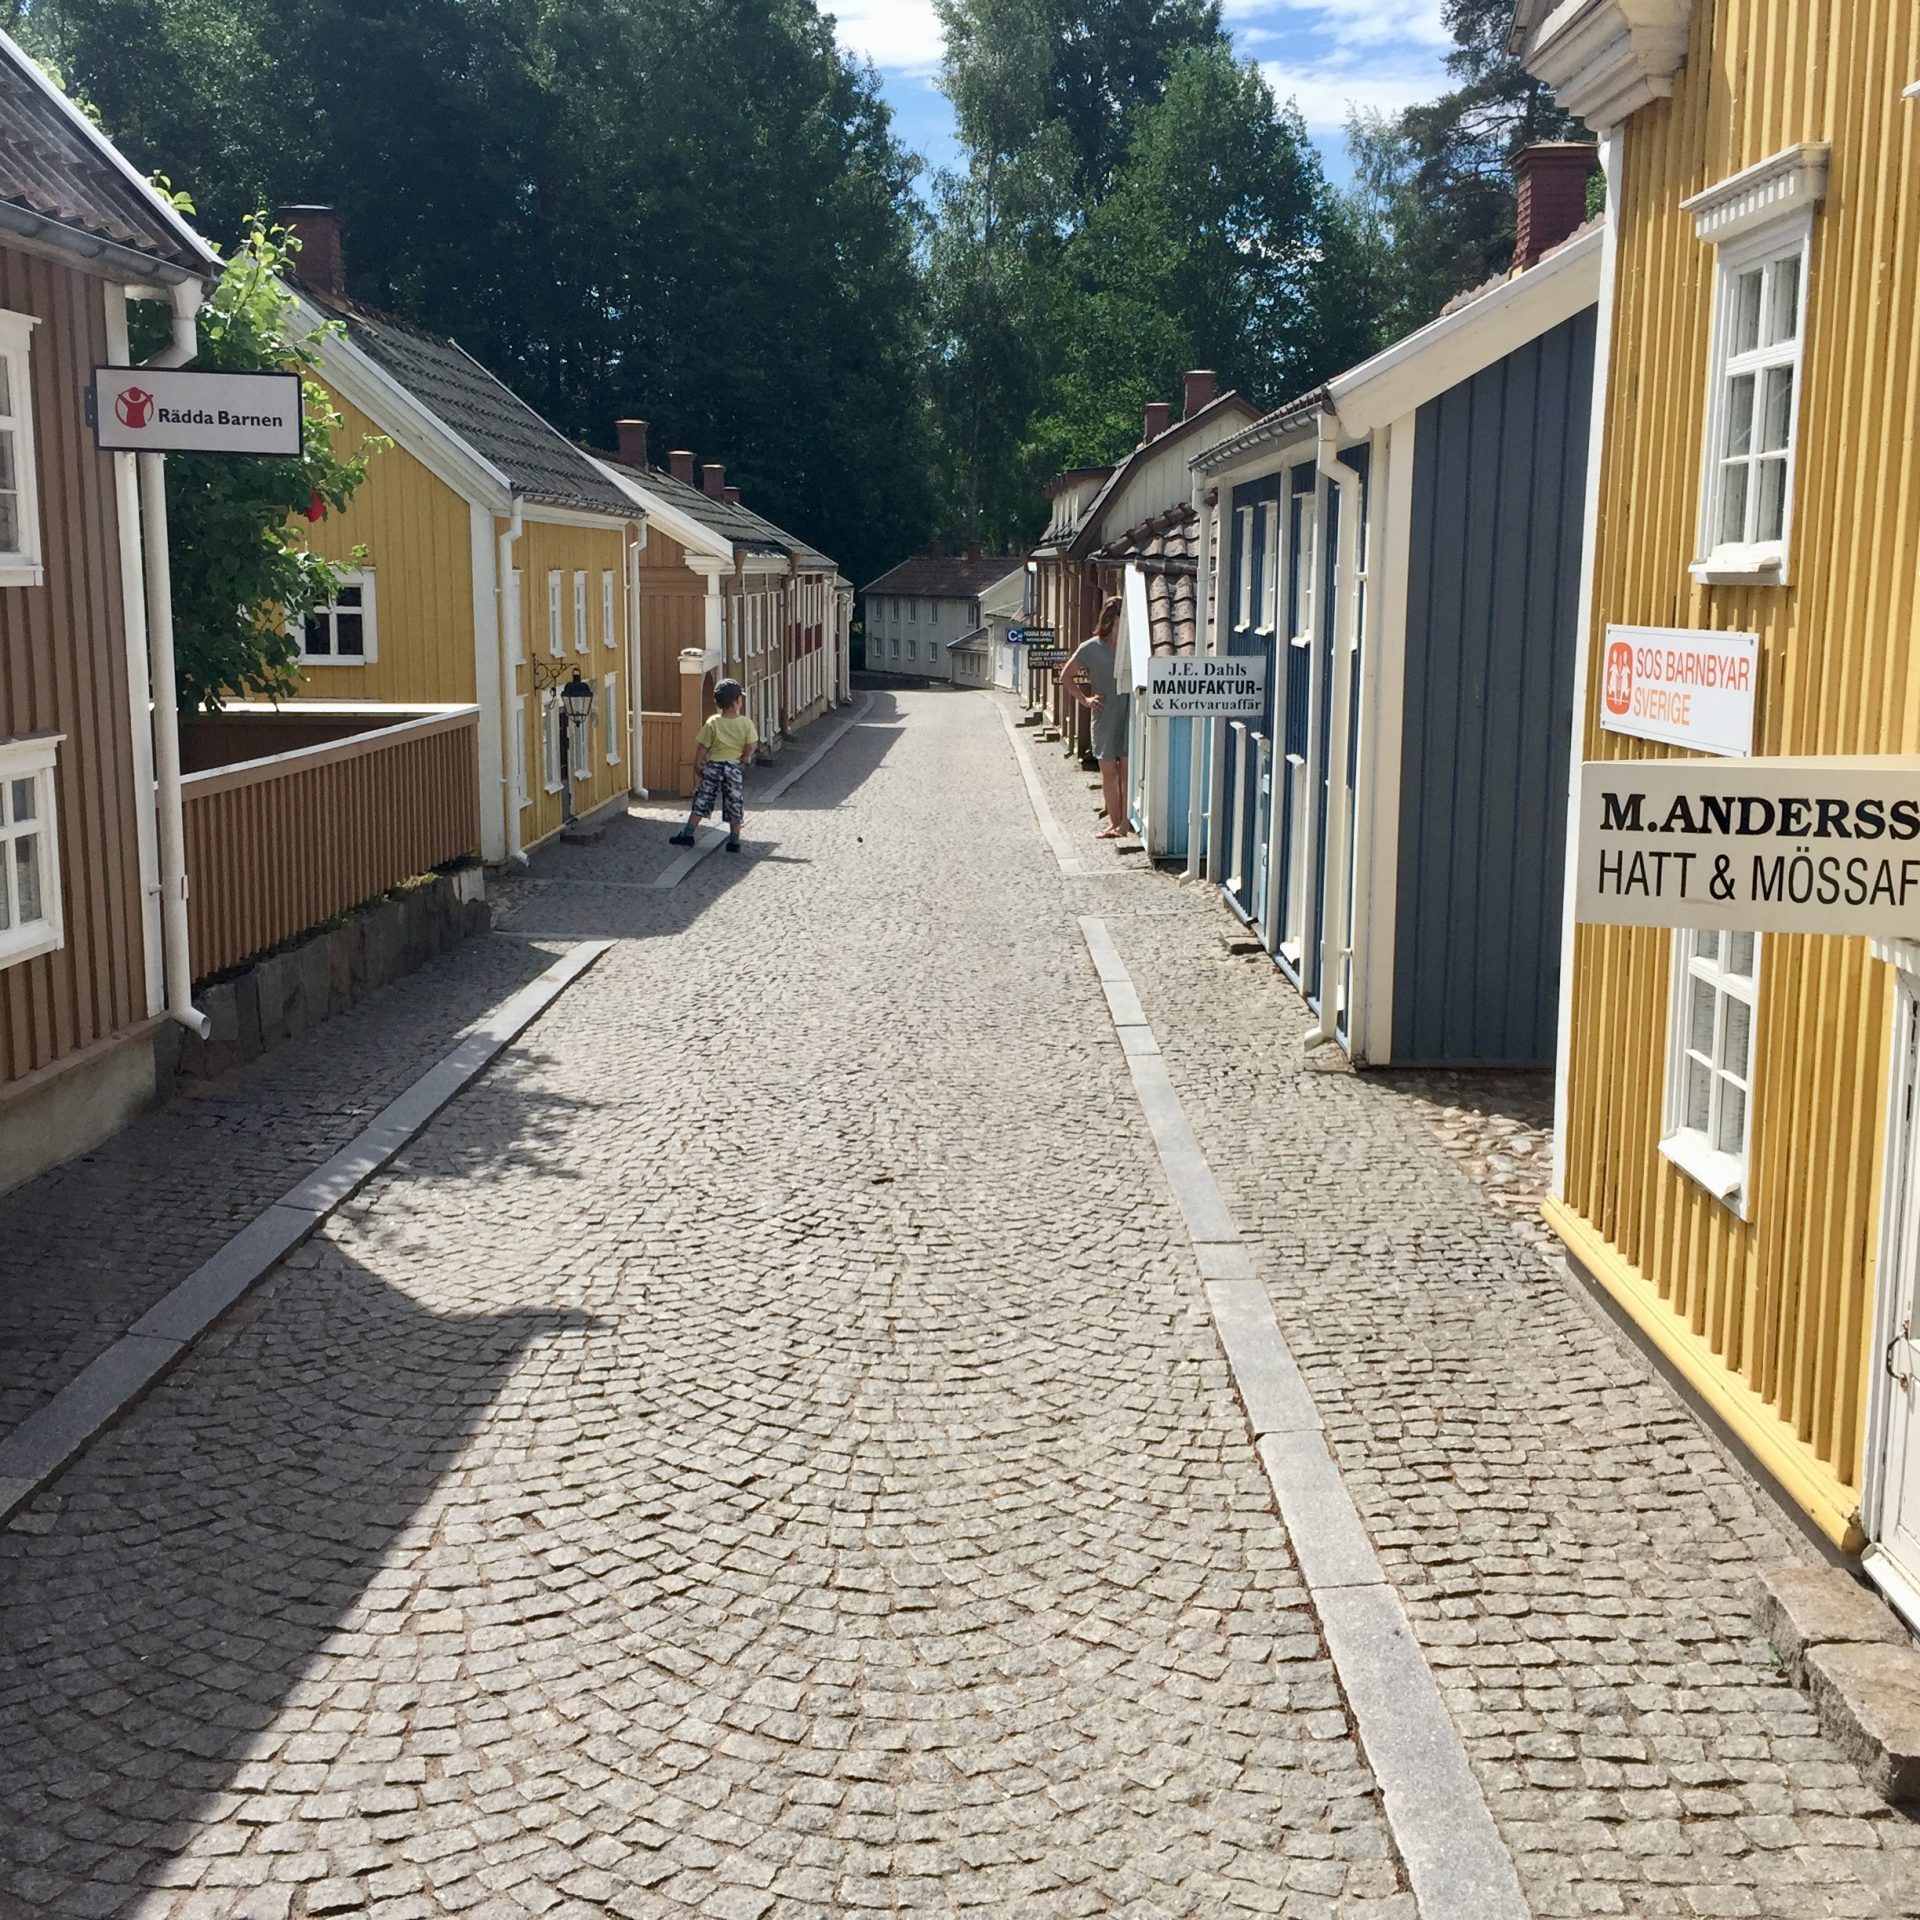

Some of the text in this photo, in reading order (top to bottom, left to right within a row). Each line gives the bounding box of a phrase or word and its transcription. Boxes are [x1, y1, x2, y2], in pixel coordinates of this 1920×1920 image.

[158, 408, 283, 427] Rädda Barnen
[1168, 662, 1247, 676] J.E. Dahls
[1636, 647, 1750, 692] SOS BARNBYAR
[1152, 680, 1262, 695] MANUFAKTUR-
[1152, 698, 1262, 710] & Kortvaruaffär
[1633, 686, 1691, 726] SVERIGE
[1598, 846, 1920, 906] HATT & MÖSSAF
